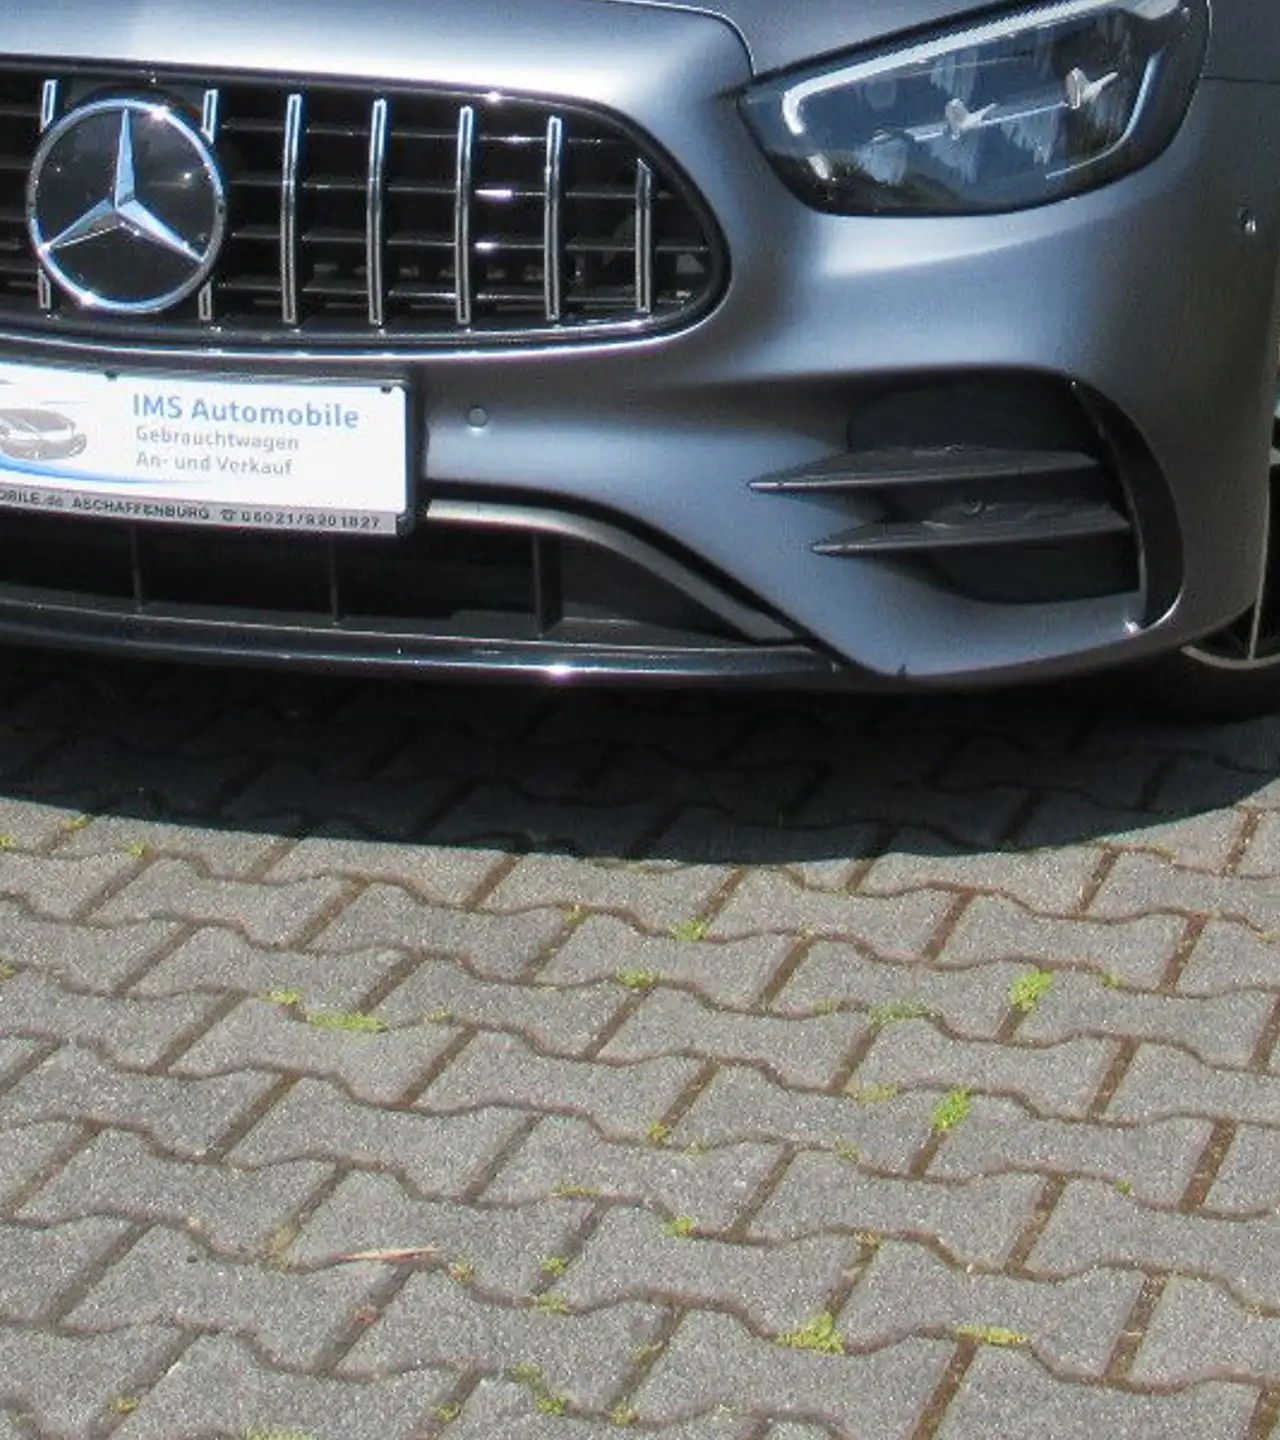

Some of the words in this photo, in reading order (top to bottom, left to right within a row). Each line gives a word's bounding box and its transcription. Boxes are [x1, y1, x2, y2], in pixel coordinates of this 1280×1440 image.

[132, 393, 184, 420] IMS
[191, 397, 360, 429] Automobile
[135, 424, 300, 452] Gebrauchtwagen
[136, 451, 169, 469] An-
[173, 454, 211, 472] und
[217, 456, 294, 477] Verkauf
[71, 497, 211, 520] ASCHAFFENBURG
